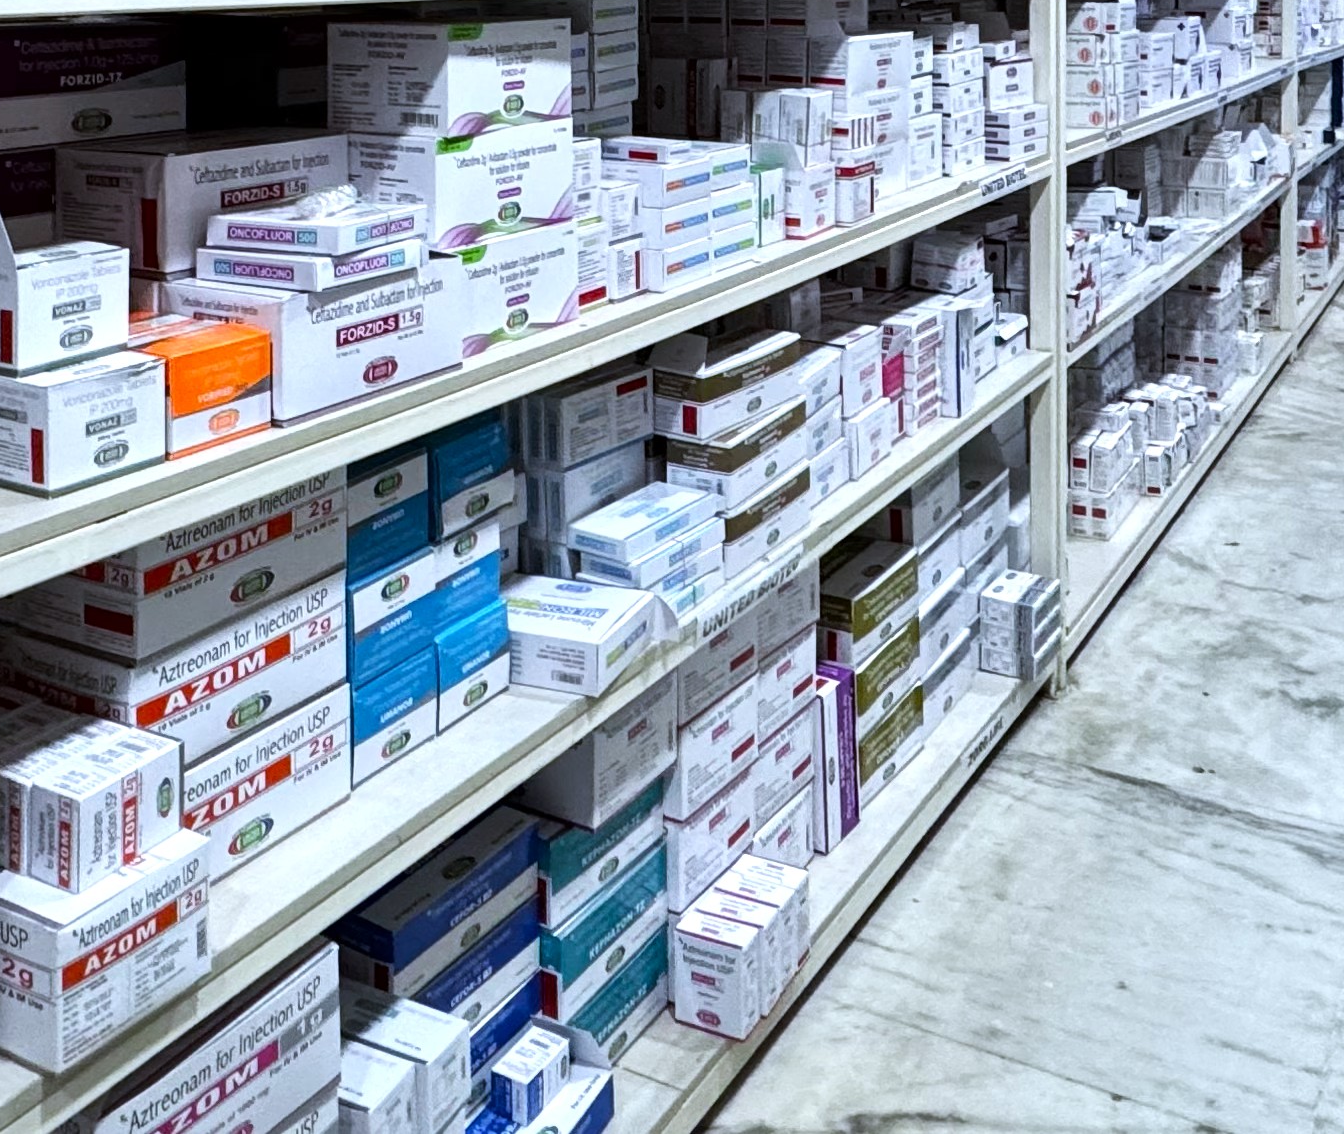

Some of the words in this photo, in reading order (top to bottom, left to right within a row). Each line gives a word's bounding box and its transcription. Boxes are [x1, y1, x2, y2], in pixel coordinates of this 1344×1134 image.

[60, 73, 122, 86] FORZID-TZ
[224, 185, 280, 205] FORZID-S
[230, 228, 293, 241] ONCOFLUOR
[298, 232, 316, 242] 500
[234, 264, 293, 280] ONCOFLUOR
[336, 257, 386, 276] ONCOFLUOR
[392, 253, 404, 264] 500
[56, 302, 84, 314] VONAZ
[311, 300, 354, 325] Ceftazidime
[371, 291, 406, 308] Sulbactam
[407, 285, 416, 299] for
[416, 279, 443, 300] Injection
[339, 317, 395, 342] FORZID-S
[400, 310, 421, 326] 1.5g
[88, 416, 119, 432] VONAZ
[166, 513, 235, 552] Aztreonam
[239, 504, 254, 522] for
[259, 484, 306, 514] Injection
[169, 523, 268, 583] AZOM
[308, 498, 332, 518] 2g
[159, 645, 231, 686] Aztreonam
[234, 631, 250, 650] for
[256, 605, 303, 638] Injection
[307, 588, 328, 612] USP
[702, 594, 754, 637] UNITED
[164, 650, 266, 716] AZOM
[308, 617, 331, 638] 2g
[236, 753, 252, 775] for
[256, 724, 304, 762] Injection
[308, 706, 330, 732] USP
[309, 734, 334, 758] 2g
[124, 804, 136, 854] AZOM
[60, 828, 70, 881] AZOM
[79, 907, 130, 948] Aztreonam
[131, 894, 142, 915] for
[145, 876, 180, 914] Injection
[183, 858, 200, 886] USP
[0, 924, 28, 950] USP
[84, 919, 156, 976] AZOM
[185, 889, 202, 910] 2g
[2, 958, 33, 988] 2g
[129, 1065, 211, 1134] Aztreonam
[216, 1047, 236, 1070] for
[239, 1004, 294, 1056] Injection
[297, 975, 320, 1012] USP
